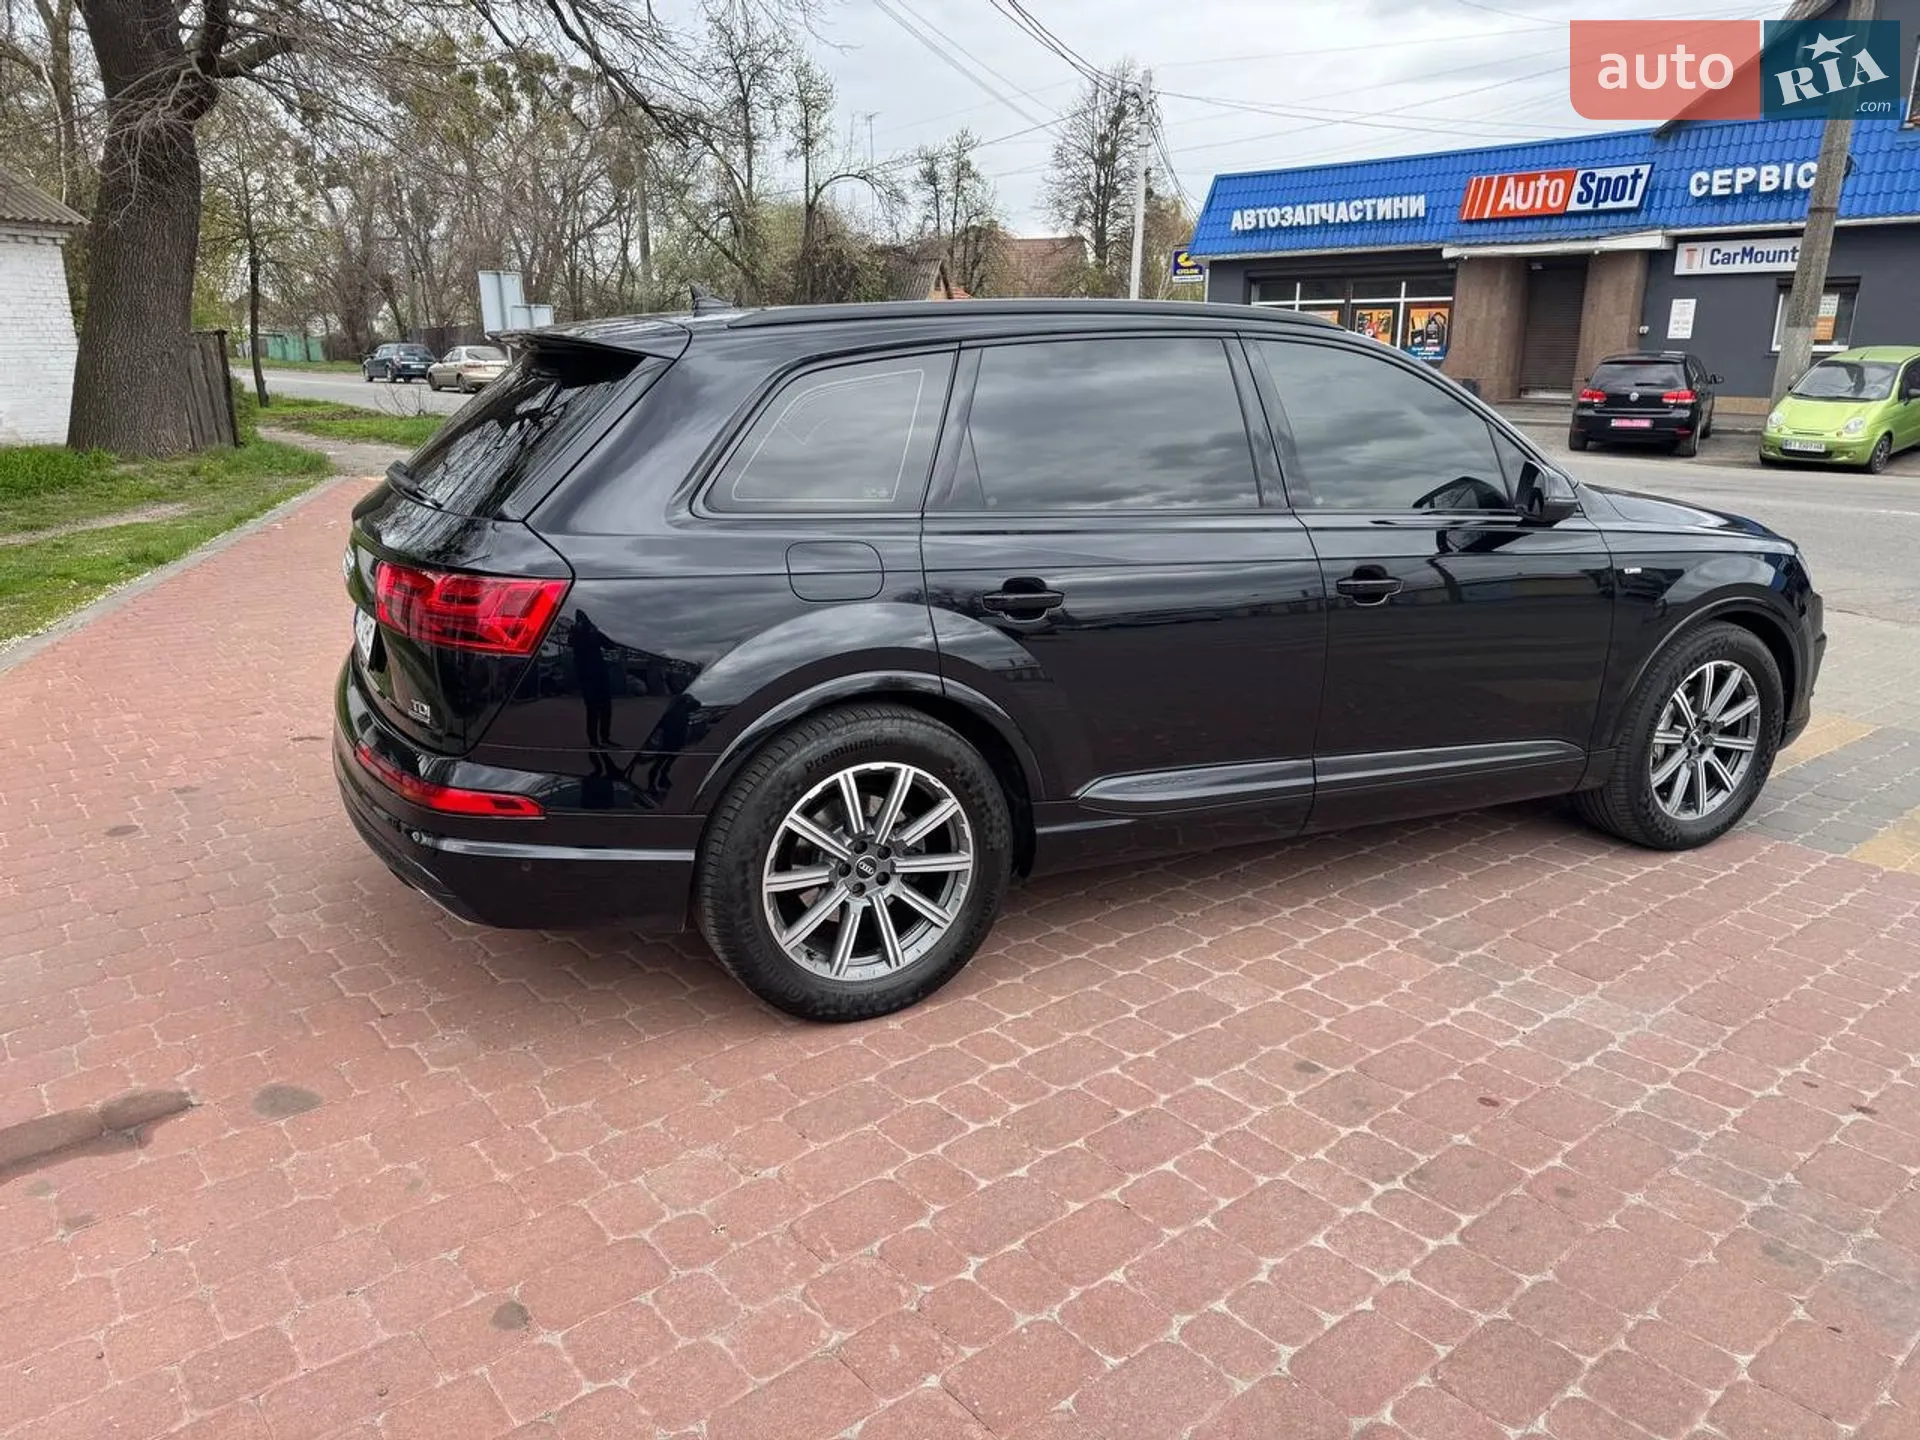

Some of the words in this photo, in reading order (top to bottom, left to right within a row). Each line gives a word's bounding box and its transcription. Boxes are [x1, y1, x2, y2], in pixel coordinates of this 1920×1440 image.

[1497, 174, 1566, 212] Auto
[1577, 168, 1643, 208] Spot
[1689, 162, 1818, 197] СЕРВІС
[1231, 194, 1425, 231] АВТОЗАПЧАСТИНИ
[1709, 246, 1799, 266] CarMount
